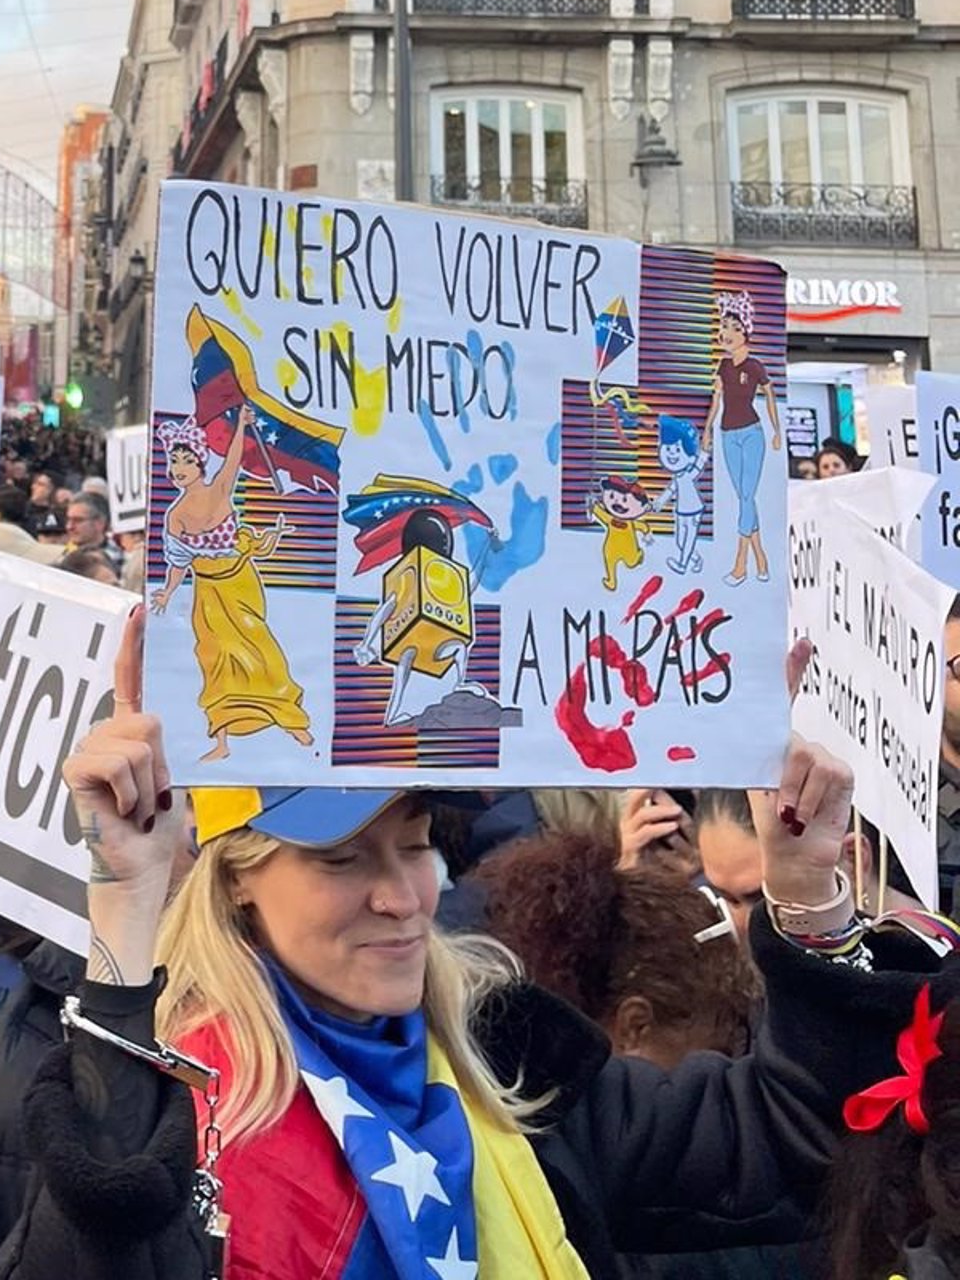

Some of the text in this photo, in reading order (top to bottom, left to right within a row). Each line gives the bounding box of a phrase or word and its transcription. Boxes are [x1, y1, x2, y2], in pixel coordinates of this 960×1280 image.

[186, 188, 602, 336] QUIERO VOLVER
[281, 326, 514, 420] SIN MIEDO
[515, 608, 548, 707] A
[563, 608, 612, 706] MI
[634, 607, 733, 707] PAÍS
[863, 581, 937, 715] MADURO
[827, 669, 933, 833] contra Venezuela!
